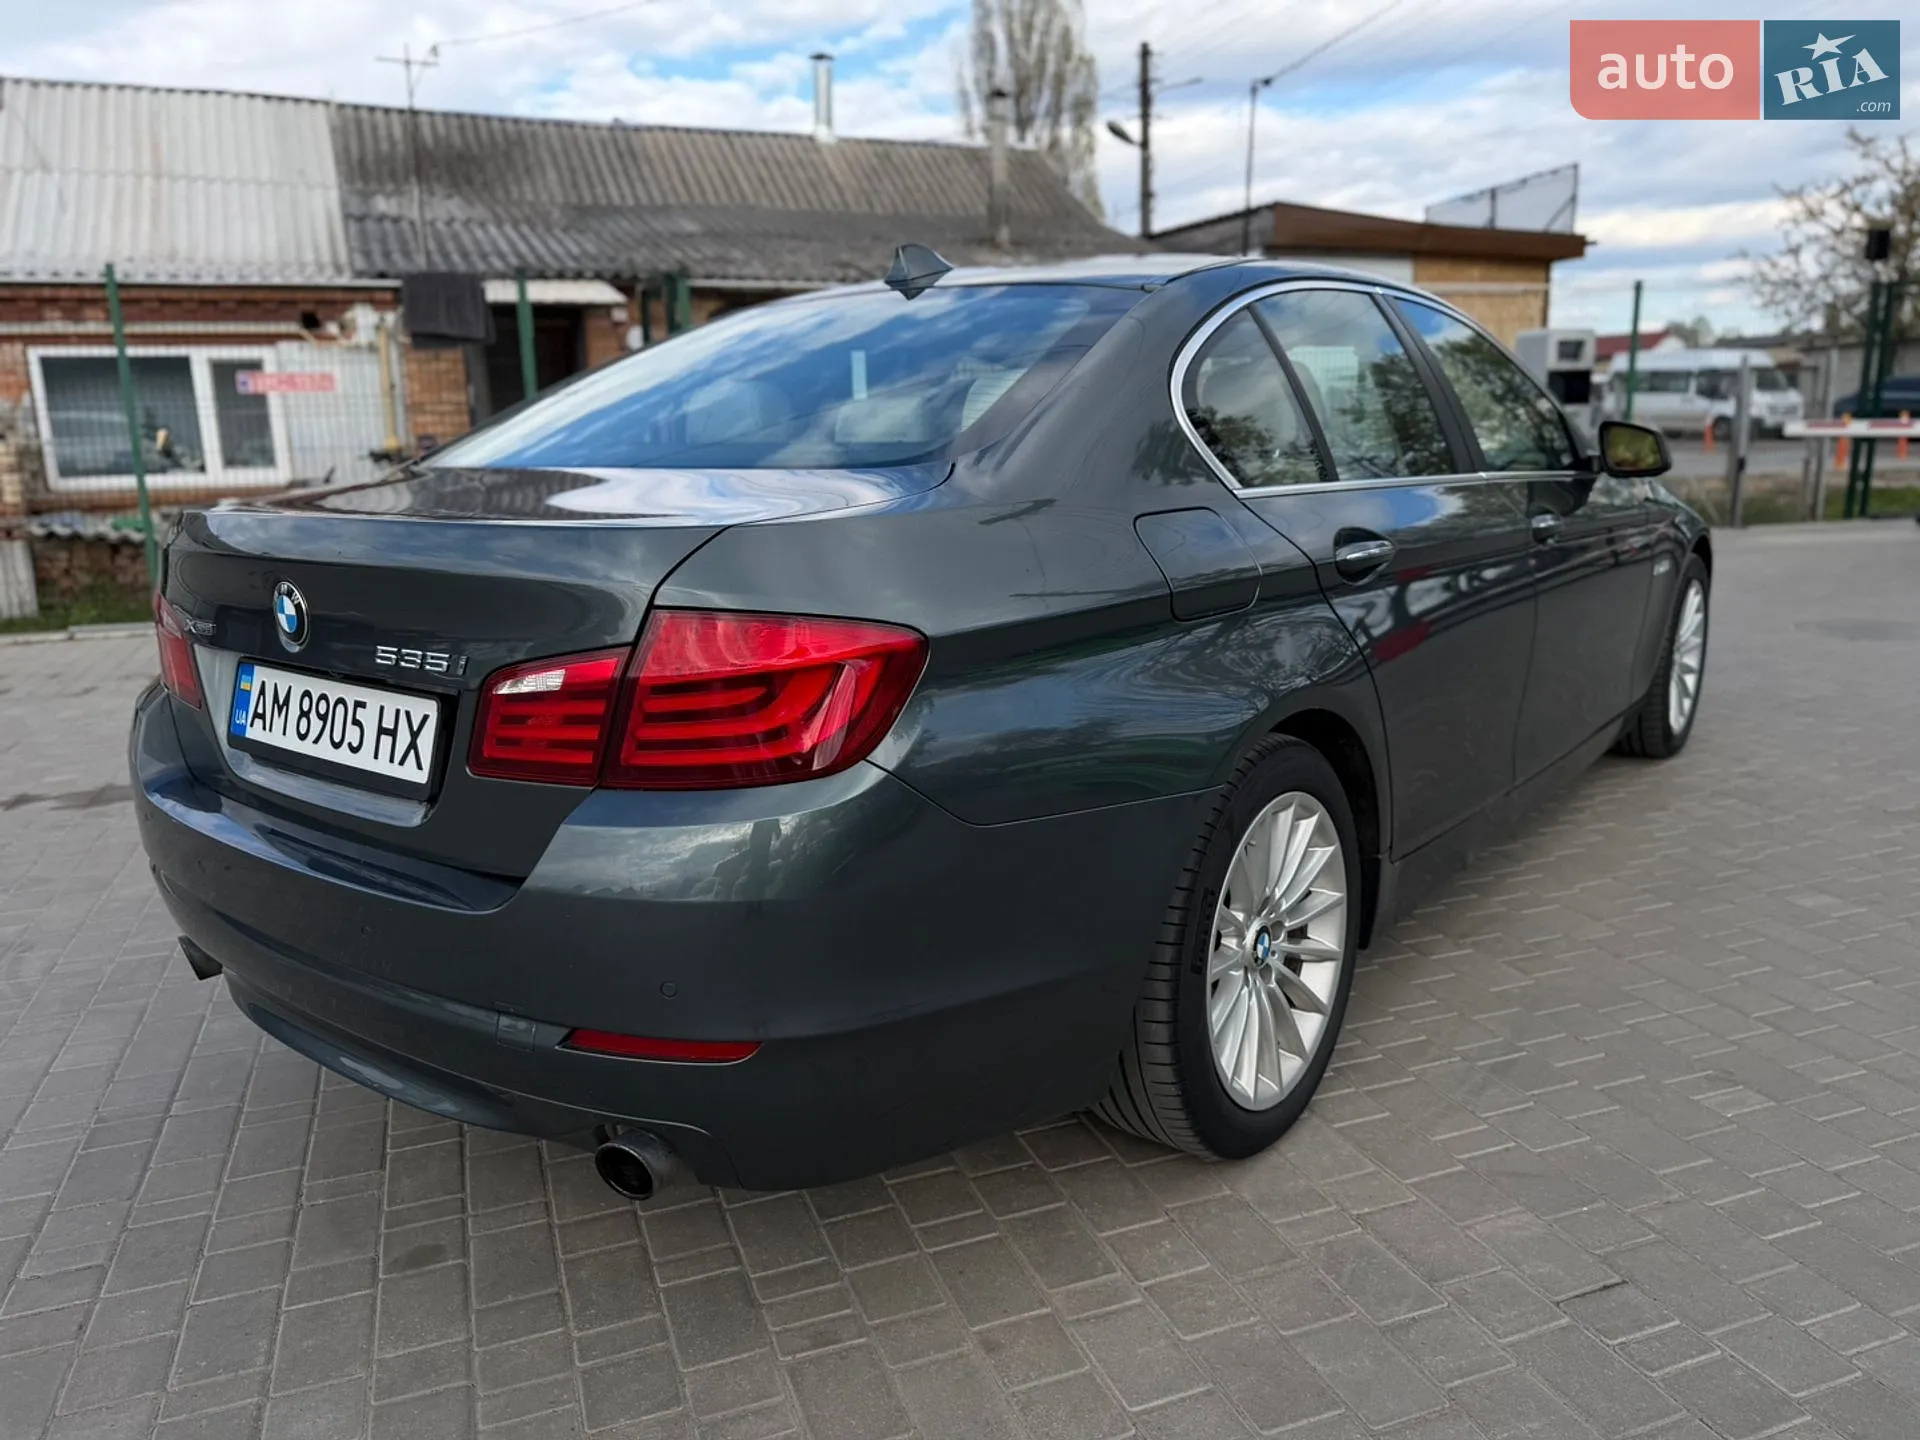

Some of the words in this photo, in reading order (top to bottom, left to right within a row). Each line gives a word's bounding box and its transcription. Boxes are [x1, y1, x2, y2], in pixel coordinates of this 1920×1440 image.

[375, 645, 467, 676] 535i
[249, 679, 292, 736] AM
[296, 689, 367, 754] 8905
[373, 704, 430, 771] HX
